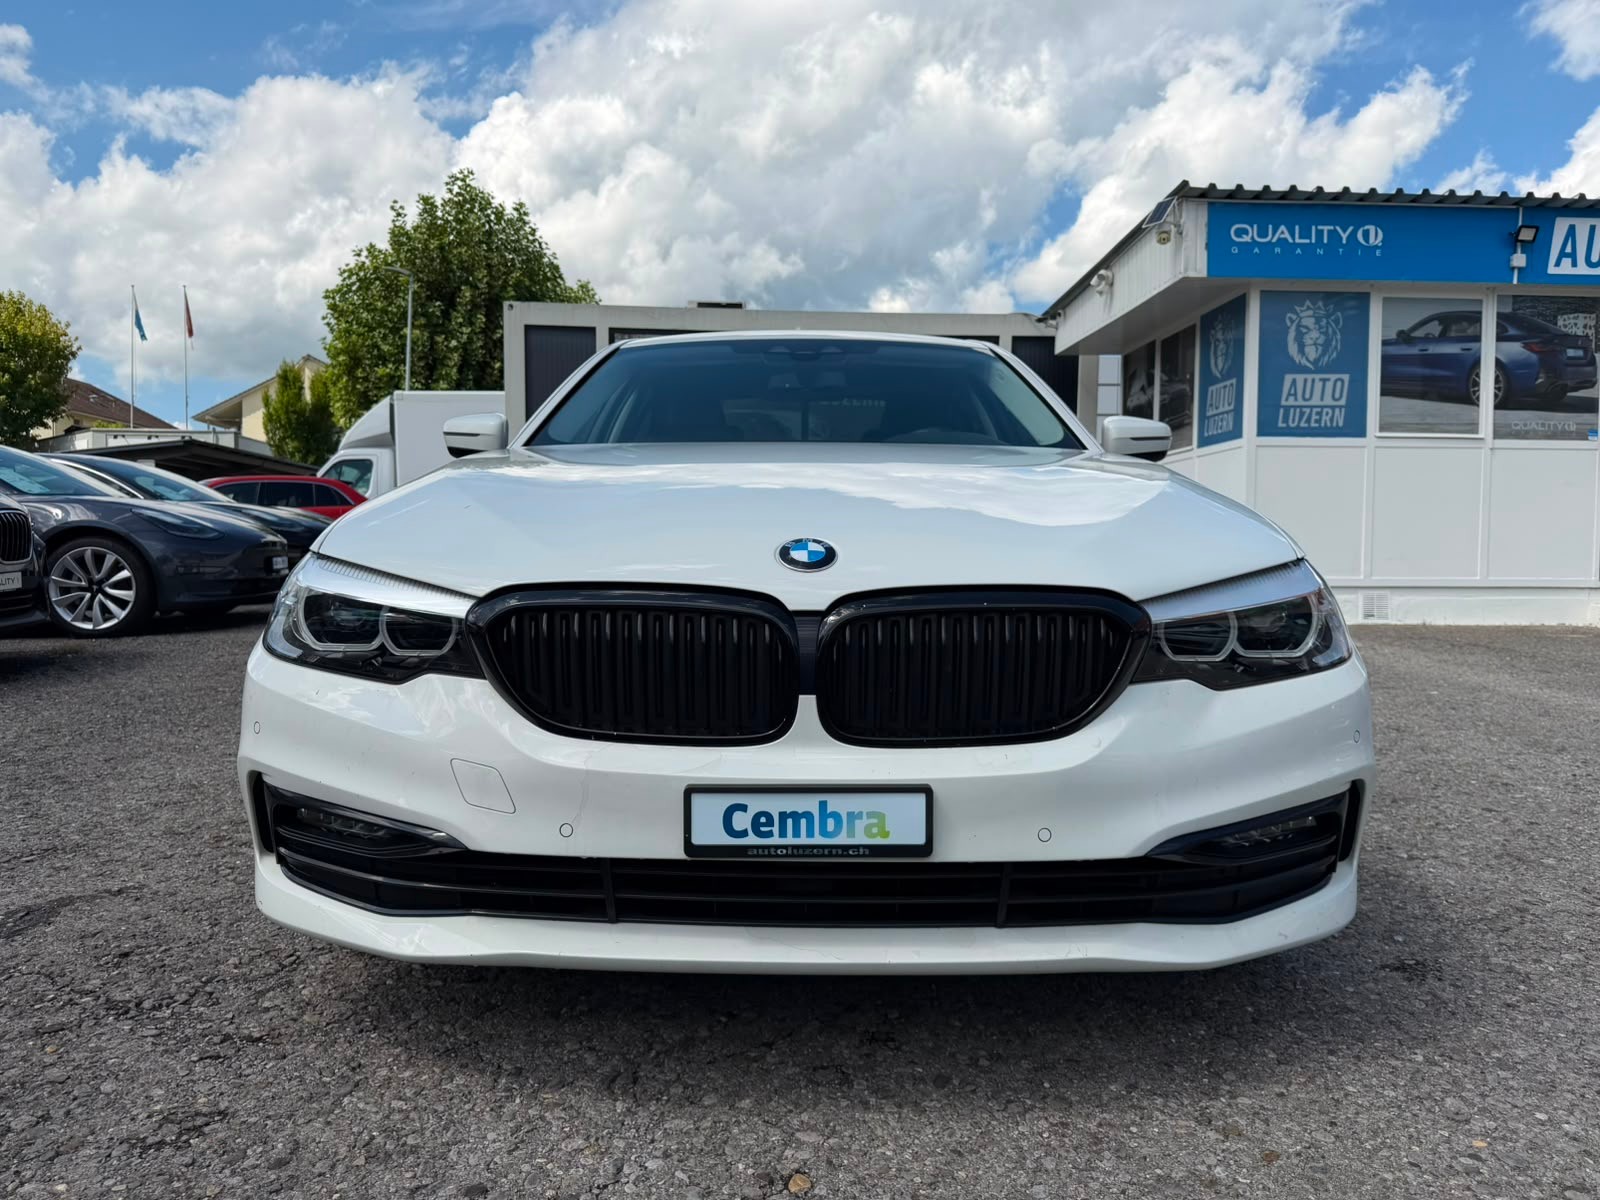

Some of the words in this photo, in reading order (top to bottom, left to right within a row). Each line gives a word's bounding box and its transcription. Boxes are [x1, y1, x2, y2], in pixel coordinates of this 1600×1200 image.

[1231, 246, 1382, 257] GARANTIE
[1207, 382, 1234, 413] AUTO
[1284, 377, 1346, 402] AUTO
[1203, 411, 1234, 437] LUZERN
[1277, 407, 1346, 428] LUZERN
[0, 576, 15, 586] LITY
[722, 799, 891, 839] Cembra
[746, 846, 871, 856] autoluzern.ch
